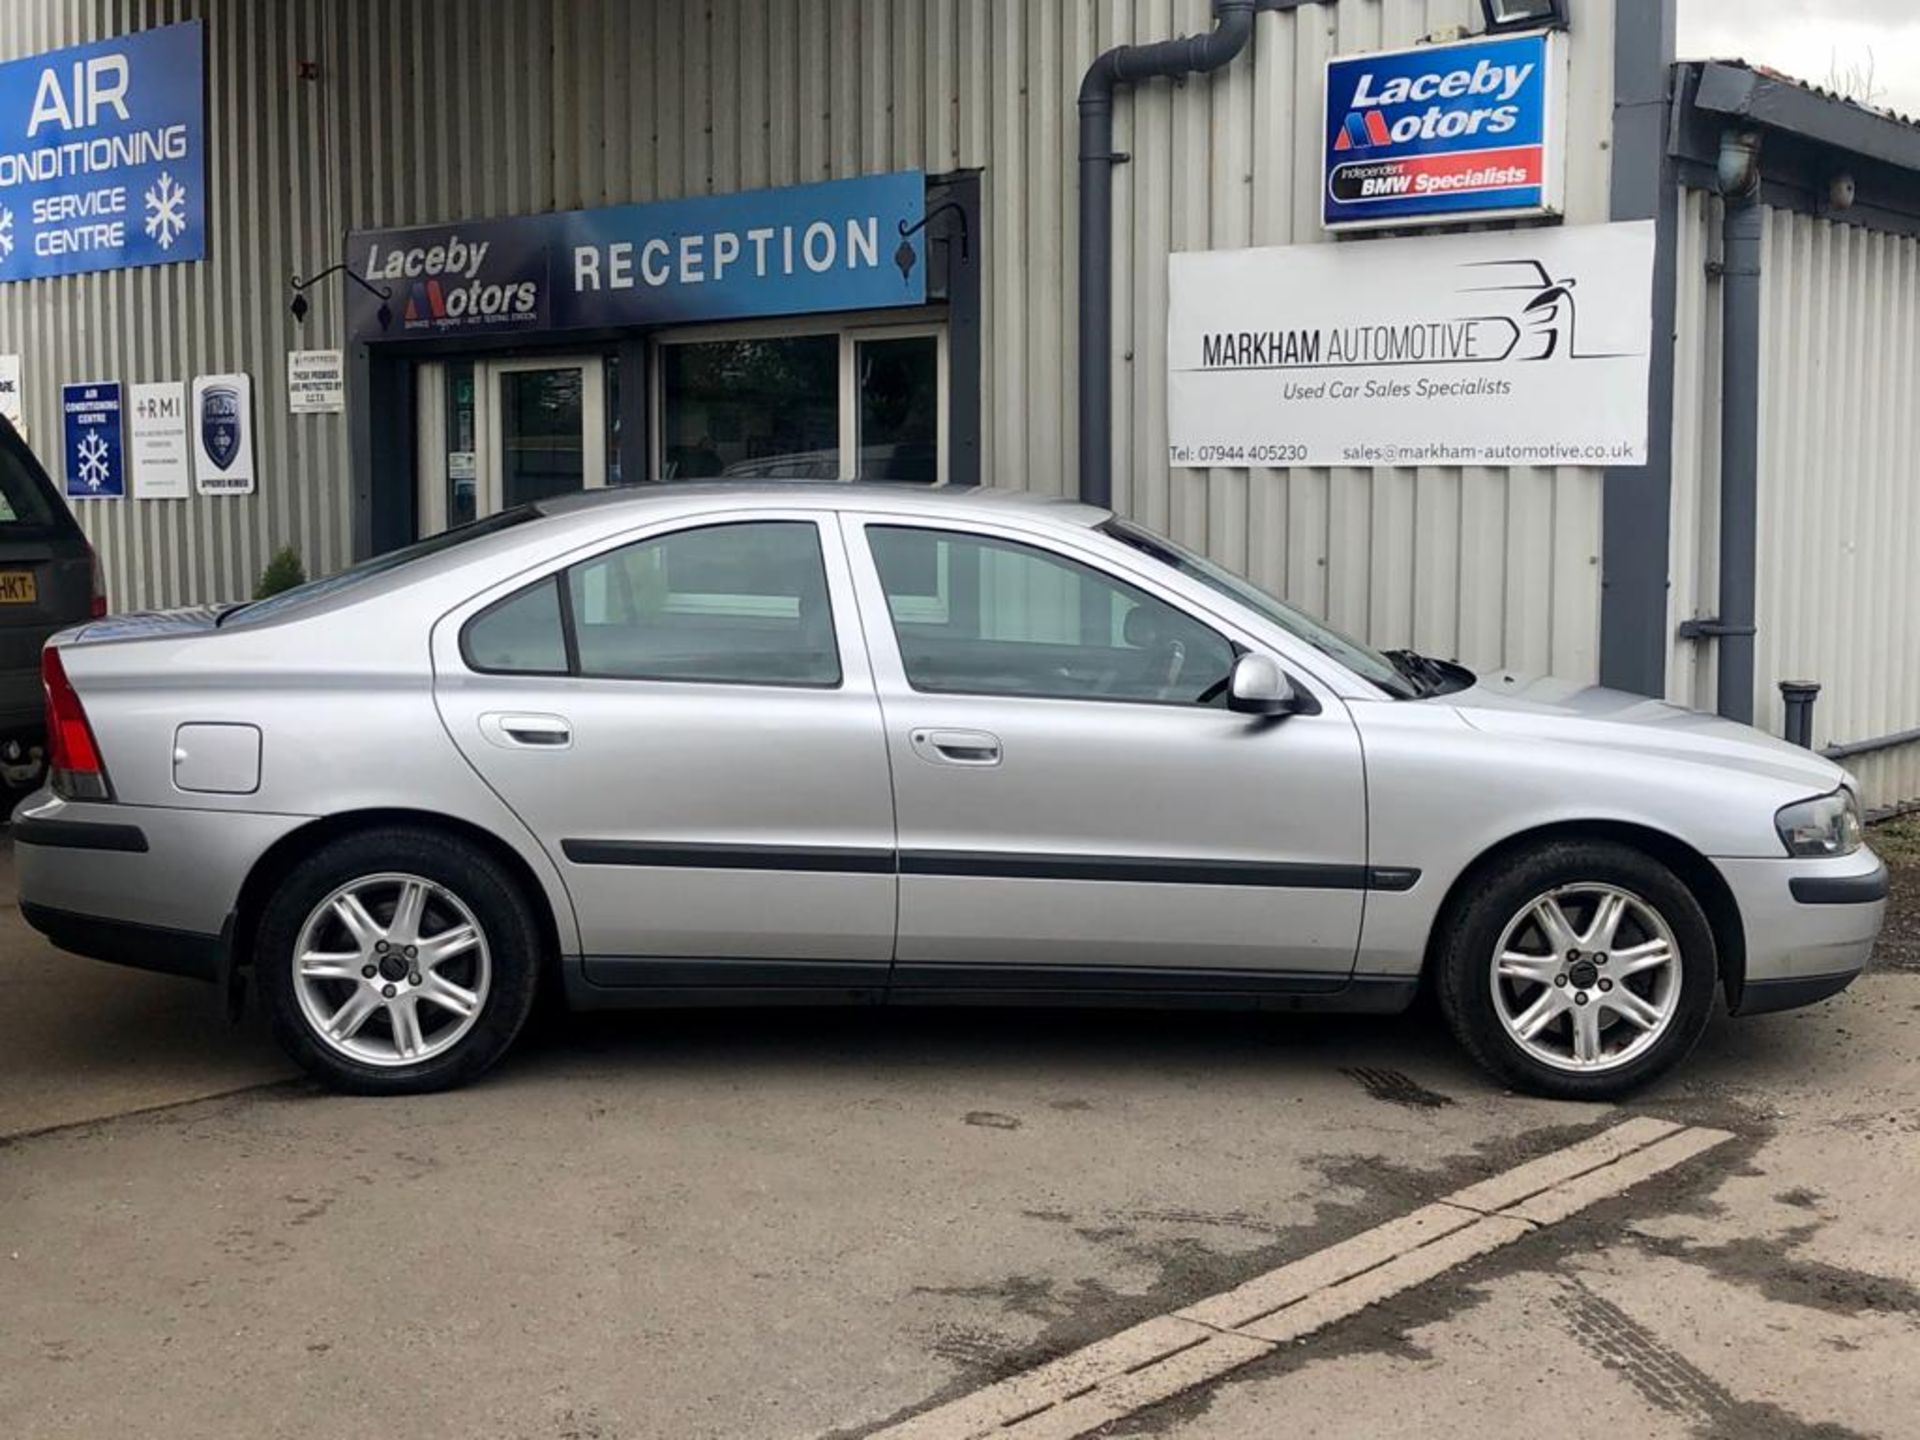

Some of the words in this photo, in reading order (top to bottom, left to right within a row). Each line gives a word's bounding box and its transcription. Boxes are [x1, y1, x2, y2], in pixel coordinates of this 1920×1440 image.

[27, 53, 130, 138] AIR
[1351, 60, 1534, 109] Laceby
[1334, 104, 1519, 151] Motors
[1341, 163, 1405, 180] Independent
[1361, 176, 1411, 197] BMW
[1414, 166, 1527, 194] Specialists
[33, 188, 126, 223] SERVICE
[35, 223, 124, 256] CENTRE
[365, 235, 490, 281] Laceby
[574, 216, 879, 292] RECEPTION
[1202, 329, 1320, 367] MARKHAM
[1326, 321, 1480, 362] AUTOMOTIVE
[1283, 382, 1325, 400] Used
[1328, 380, 1360, 398] Car
[1363, 379, 1412, 398] Sales
[1415, 377, 1513, 398] Specialists
[1169, 445, 1195, 461] Tel:
[1198, 445, 1245, 461] 07944
[1248, 444, 1308, 461] 405230
[1342, 441, 1634, 463] sales@markham-automotive.co.uk
